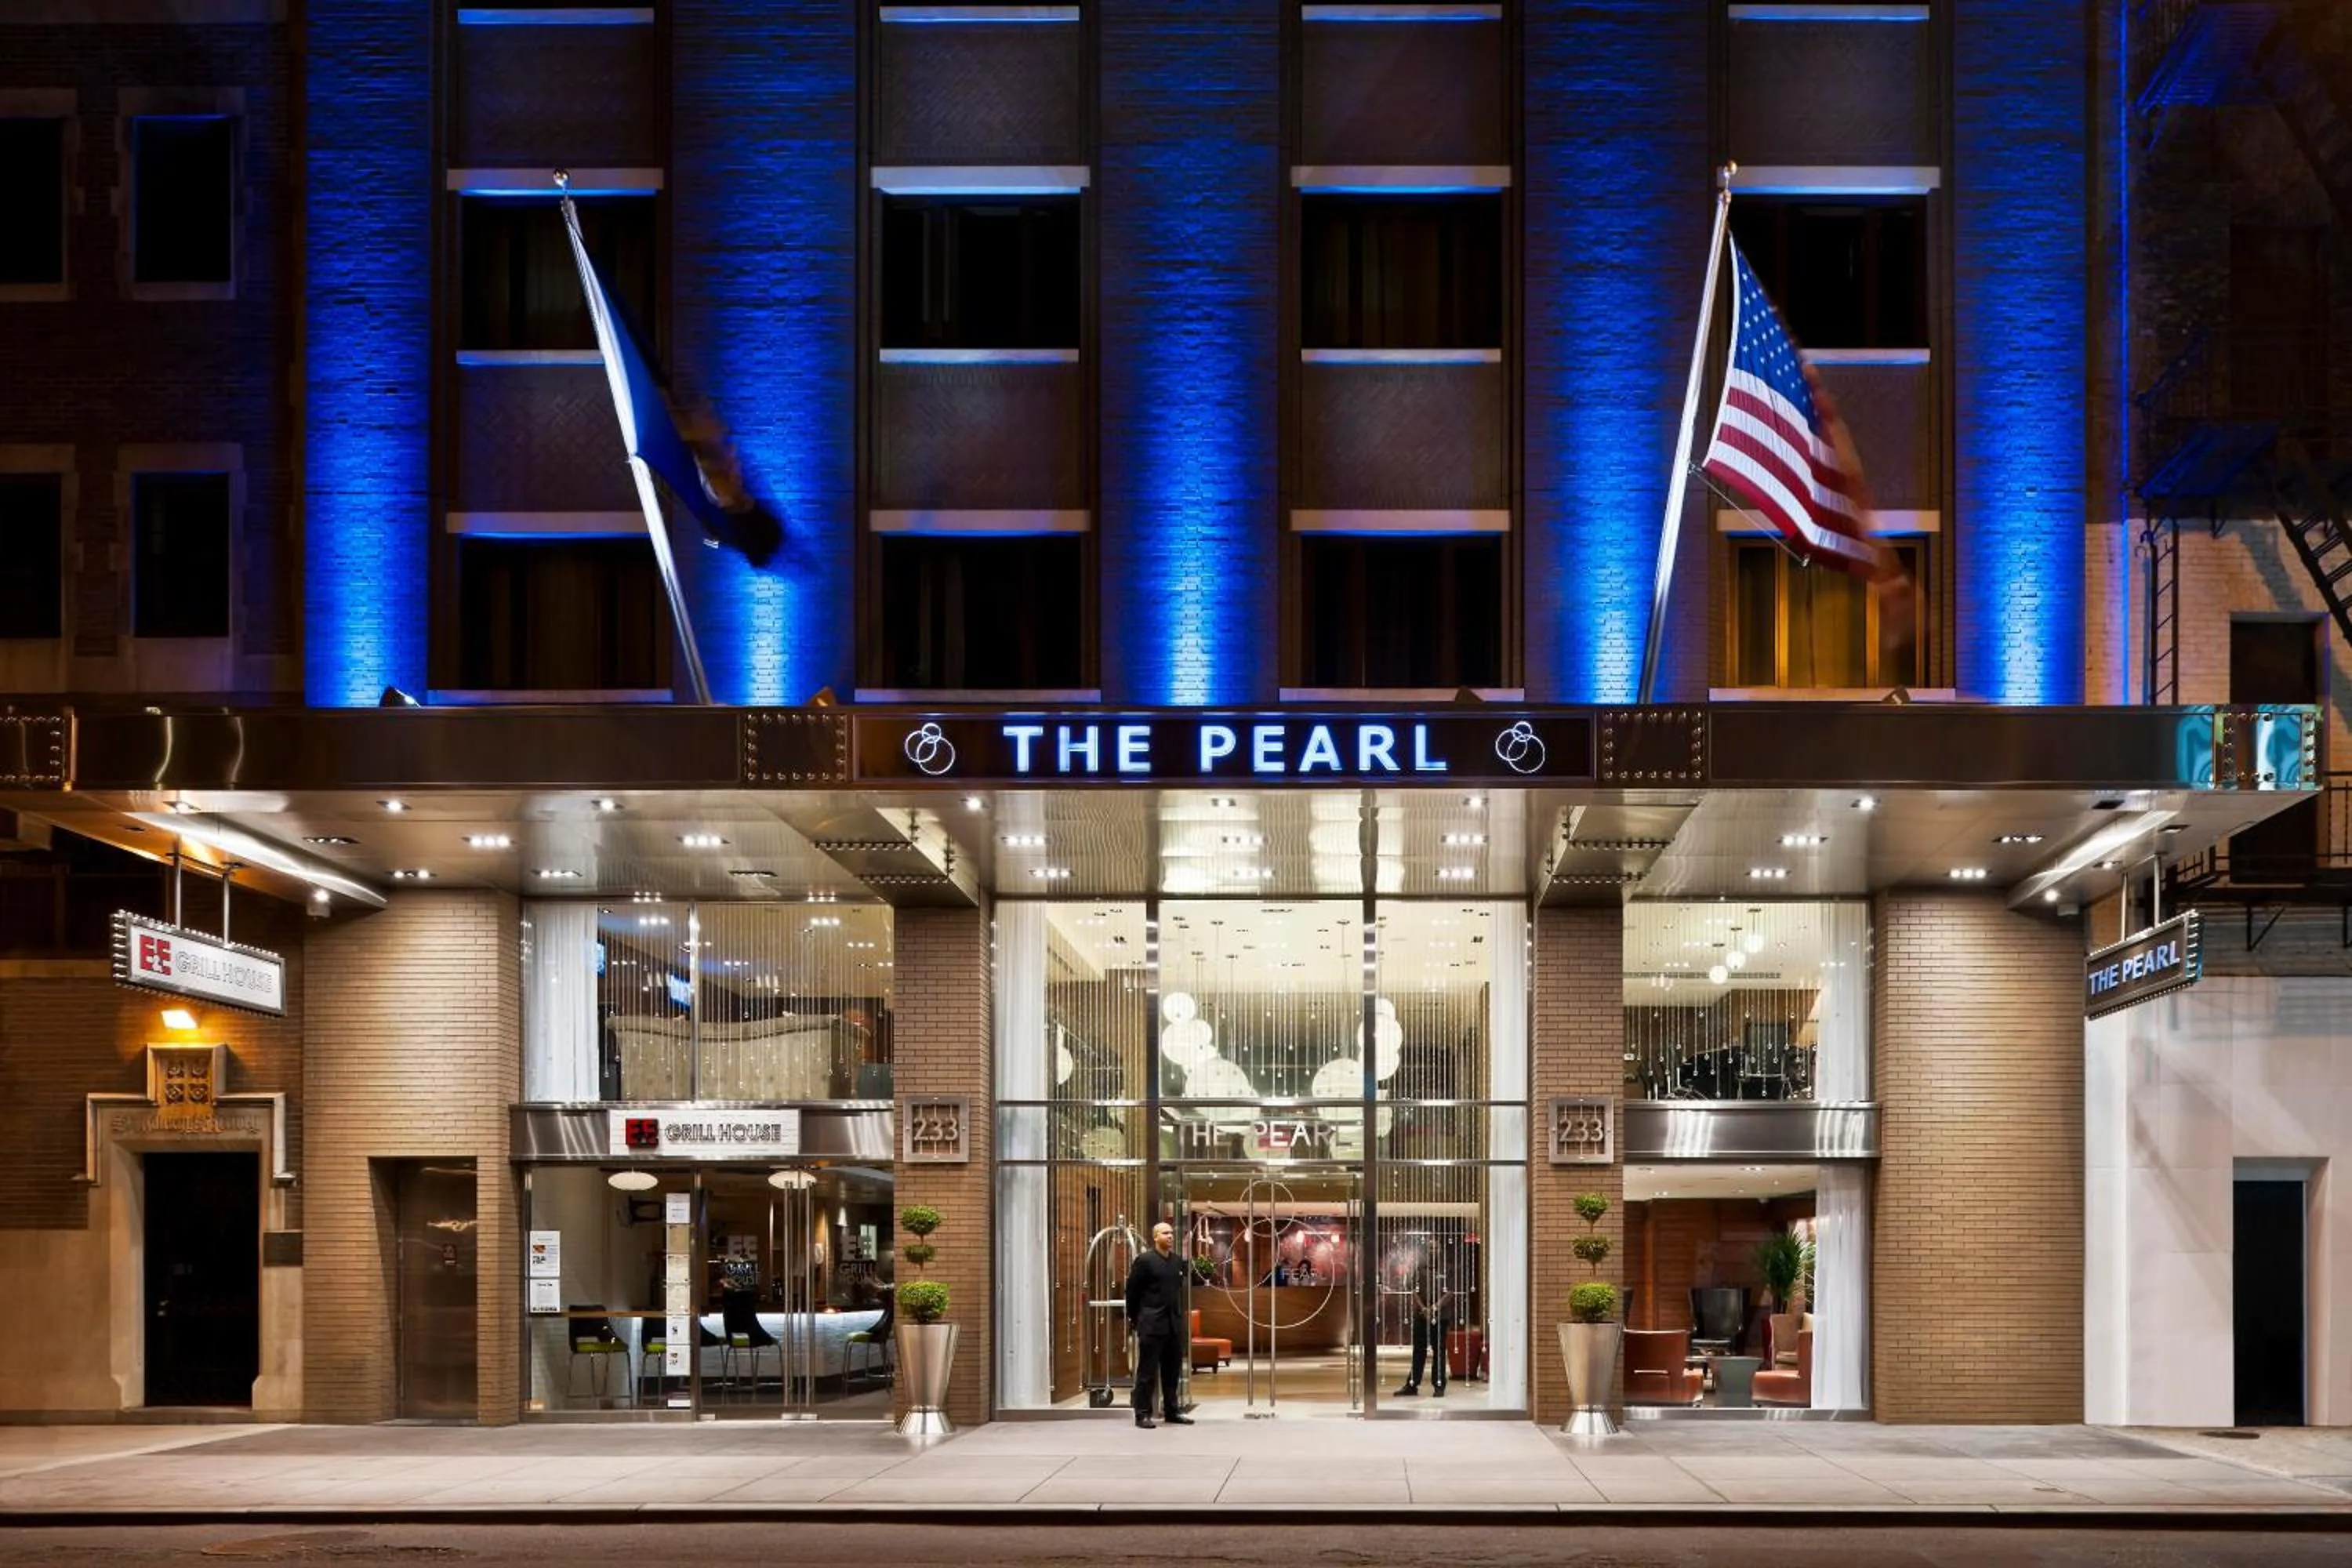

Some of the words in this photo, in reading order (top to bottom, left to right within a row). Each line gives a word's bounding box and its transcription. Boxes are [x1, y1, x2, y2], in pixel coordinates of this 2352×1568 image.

[1003, 725, 1152, 772] THE
[1200, 725, 1447, 771] PEARL
[176, 951, 220, 981] GRILL
[223, 962, 273, 993] HOUSE
[2089, 964, 2119, 995] THE
[2122, 940, 2181, 982] PEARL
[665, 1123, 715, 1142] GRILL
[718, 1123, 782, 1142] HOUSE
[913, 1118, 958, 1141] 233
[1178, 1121, 1231, 1148] THE
[1254, 1120, 1353, 1147] PEARL
[1559, 1119, 1604, 1142] 233
